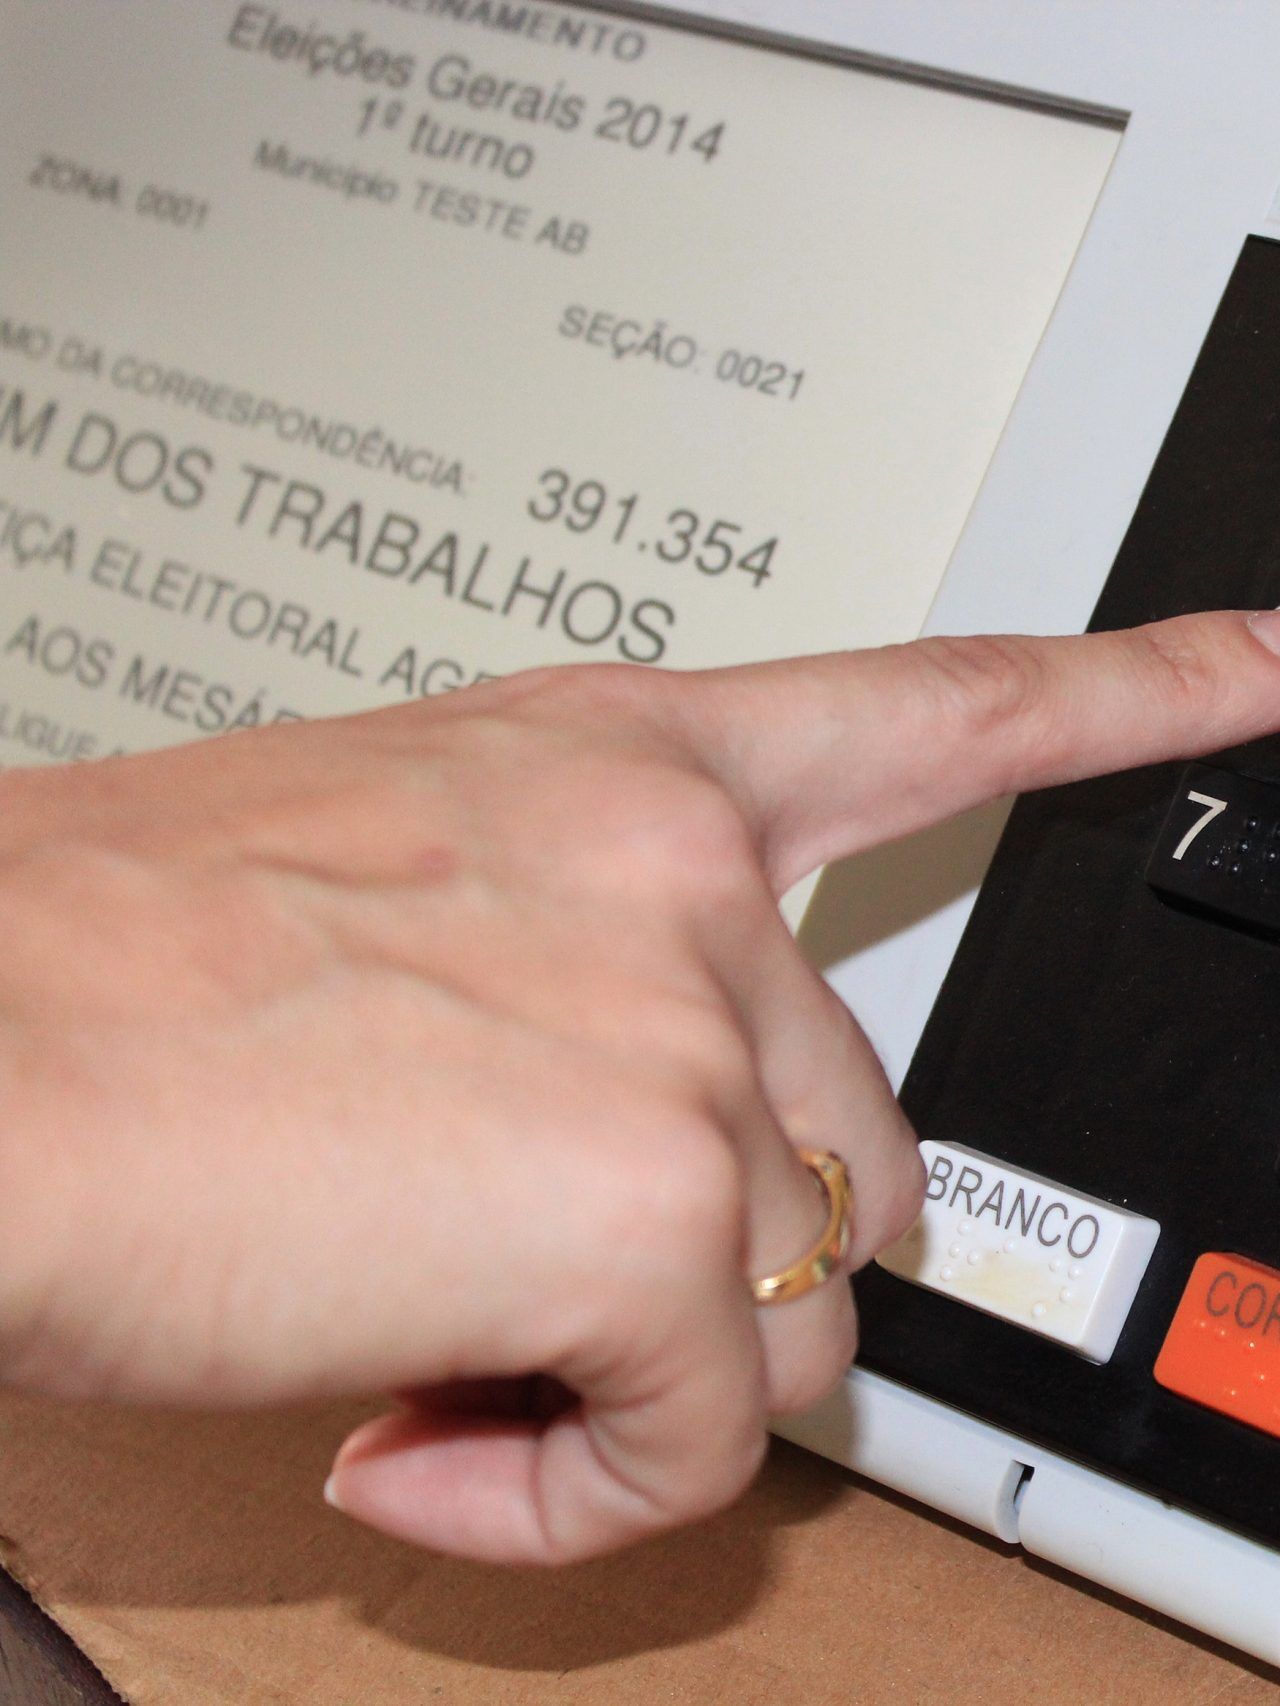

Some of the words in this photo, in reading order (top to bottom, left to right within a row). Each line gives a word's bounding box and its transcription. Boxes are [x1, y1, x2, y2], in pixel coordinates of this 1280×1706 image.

[226, 3, 416, 89] Eleições
[427, 53, 587, 132] Gerais
[594, 97, 727, 164] 2014
[409, 113, 536, 180] turno
[413, 181, 532, 241] TESTE
[534, 217, 590, 257] AB
[714, 348, 806, 402] 0021
[56, 335, 103, 376] DA
[526, 467, 779, 588] 391.354
[65, 410, 214, 510] DOS
[233, 461, 676, 664] TRABALHOS
[4, 613, 115, 688] AOS
[118, 653, 304, 733] MESÁ
[89, 537, 363, 678] ELEITORAL
[379, 645, 501, 698] AG
[1172, 790, 1228, 861] 7
[925, 1155, 1100, 1259] BRANCO
